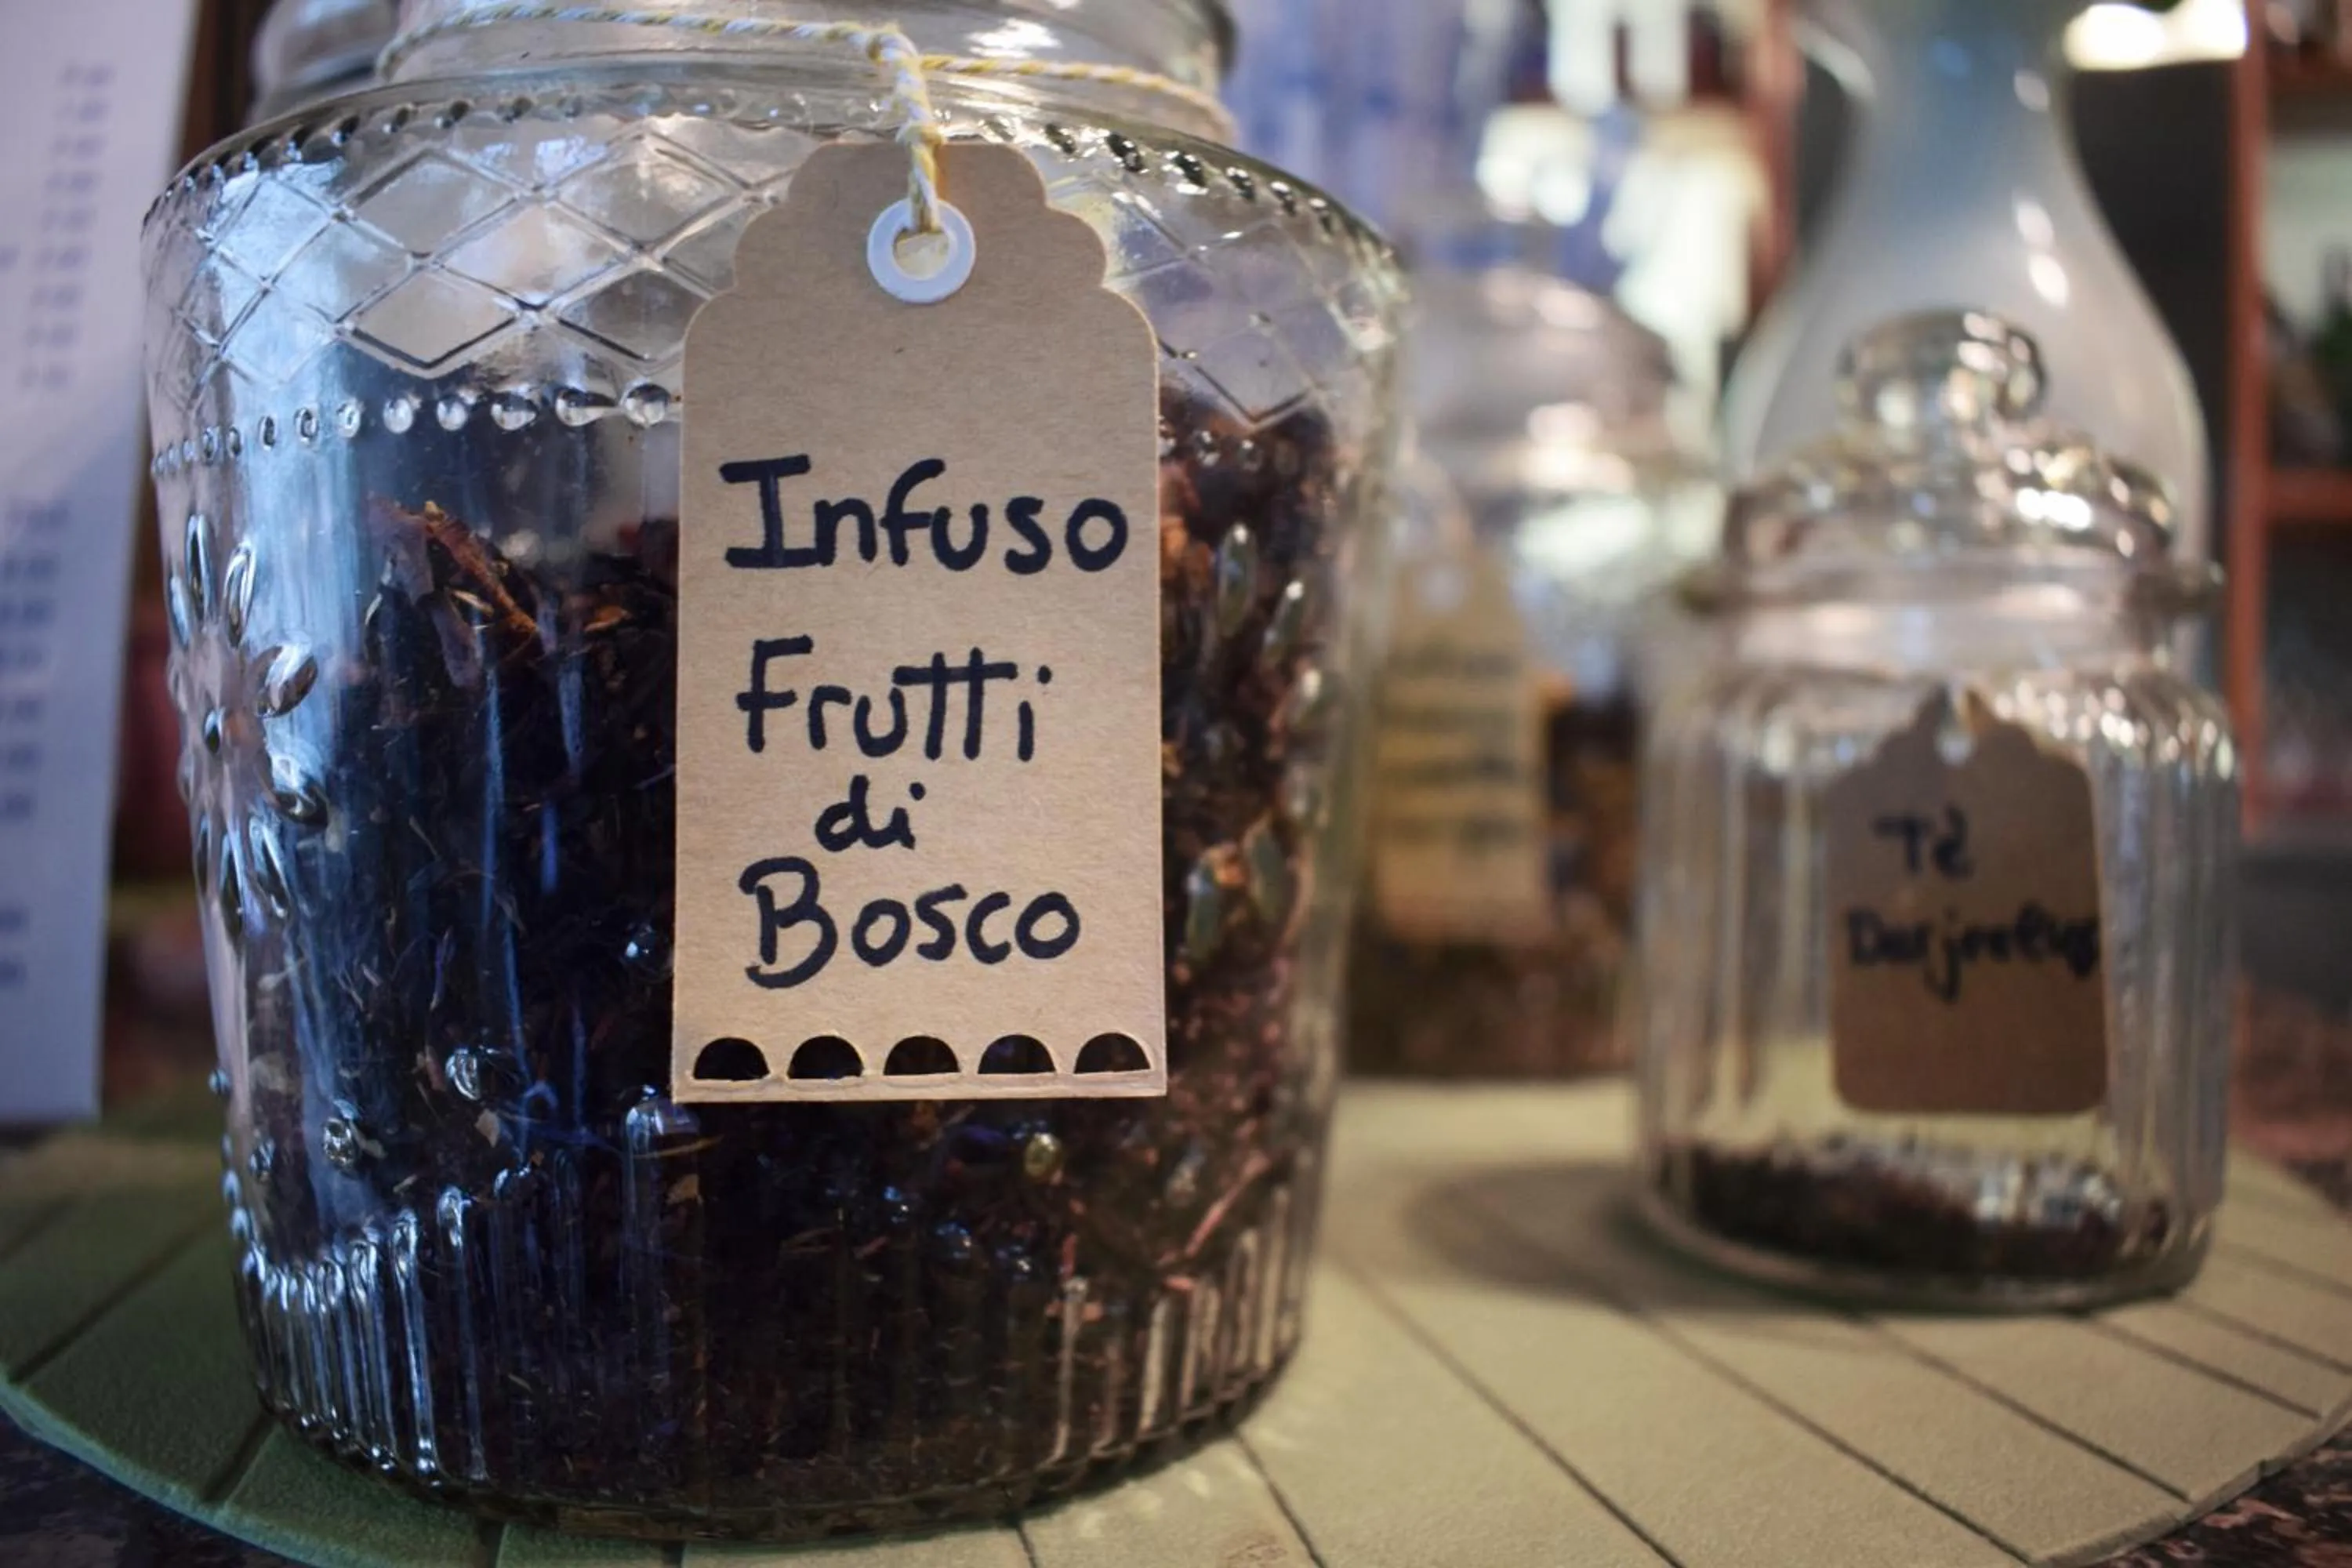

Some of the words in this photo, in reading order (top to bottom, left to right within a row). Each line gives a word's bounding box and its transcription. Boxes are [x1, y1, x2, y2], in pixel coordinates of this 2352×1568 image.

[720, 454, 1129, 575] Infuso
[736, 635, 1052, 762] Frutti
[815, 775, 925, 851] di
[739, 856, 1080, 989] Bosco
